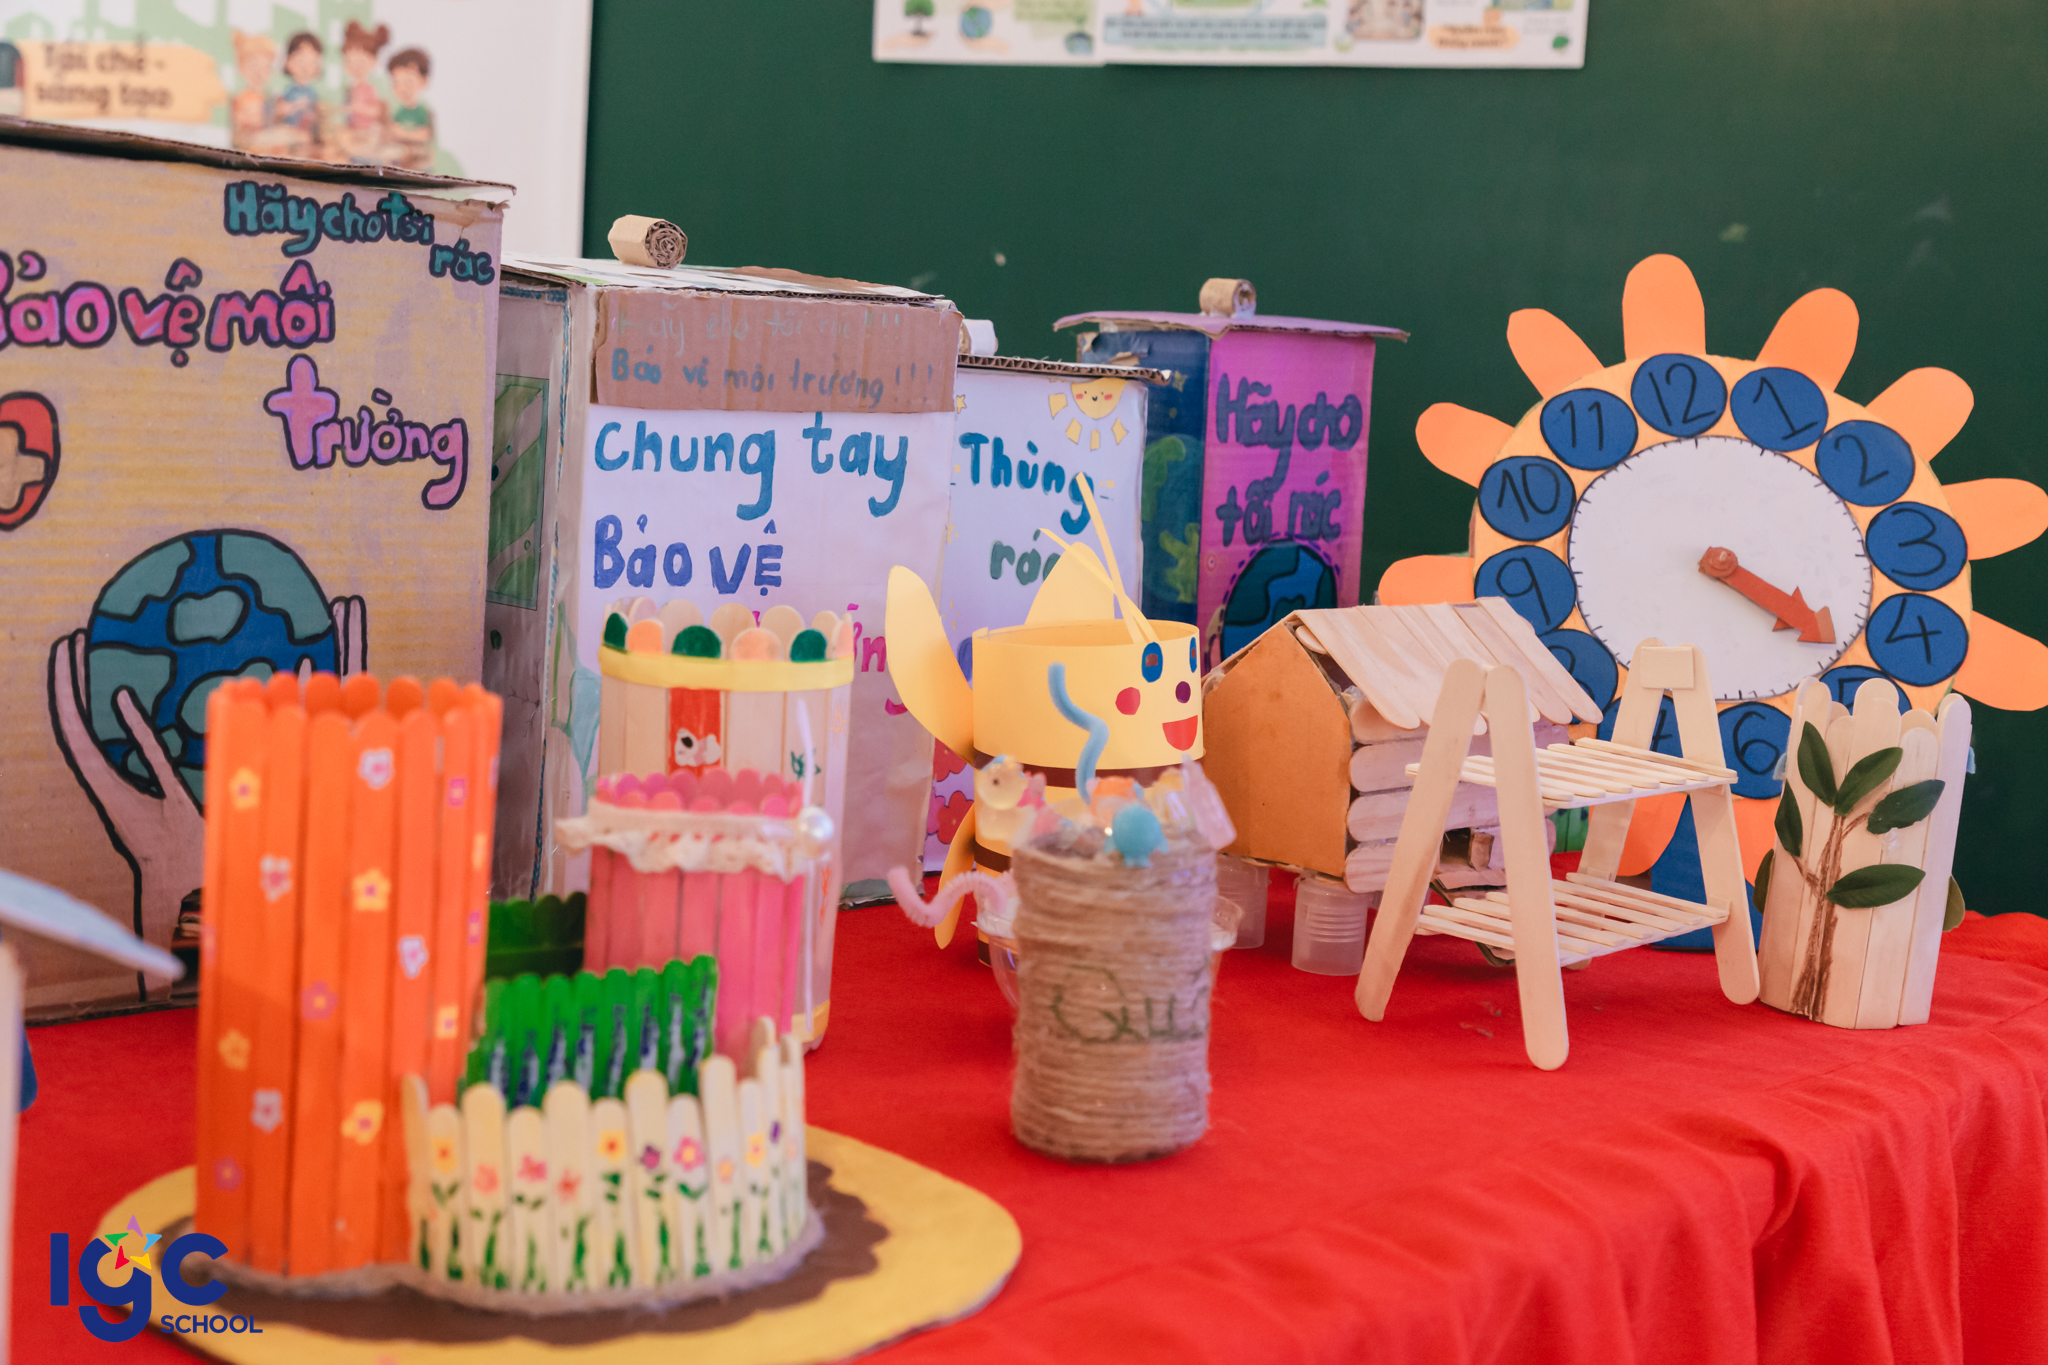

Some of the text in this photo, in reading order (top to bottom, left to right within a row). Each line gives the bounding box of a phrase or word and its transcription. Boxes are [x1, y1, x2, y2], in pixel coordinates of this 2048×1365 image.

[224, 181, 321, 257] Hãy
[322, 192, 386, 243] cho
[429, 238, 495, 286] rác
[0, 251, 335, 367] ảo vệ môi
[1561, 401, 1603, 450] 11
[1649, 363, 1716, 426] 12
[1753, 376, 1818, 440] 1
[594, 411, 908, 521] Chung tay
[959, 432, 1094, 535] Thùng
[1497, 463, 1560, 523] 10
[1834, 435, 1889, 487] 2
[594, 514, 692, 589] Bảo
[1891, 508, 1946, 578] 3
[1495, 556, 1552, 627] 9
[1884, 597, 1942, 665] 4
[1733, 712, 1780, 775] 6
